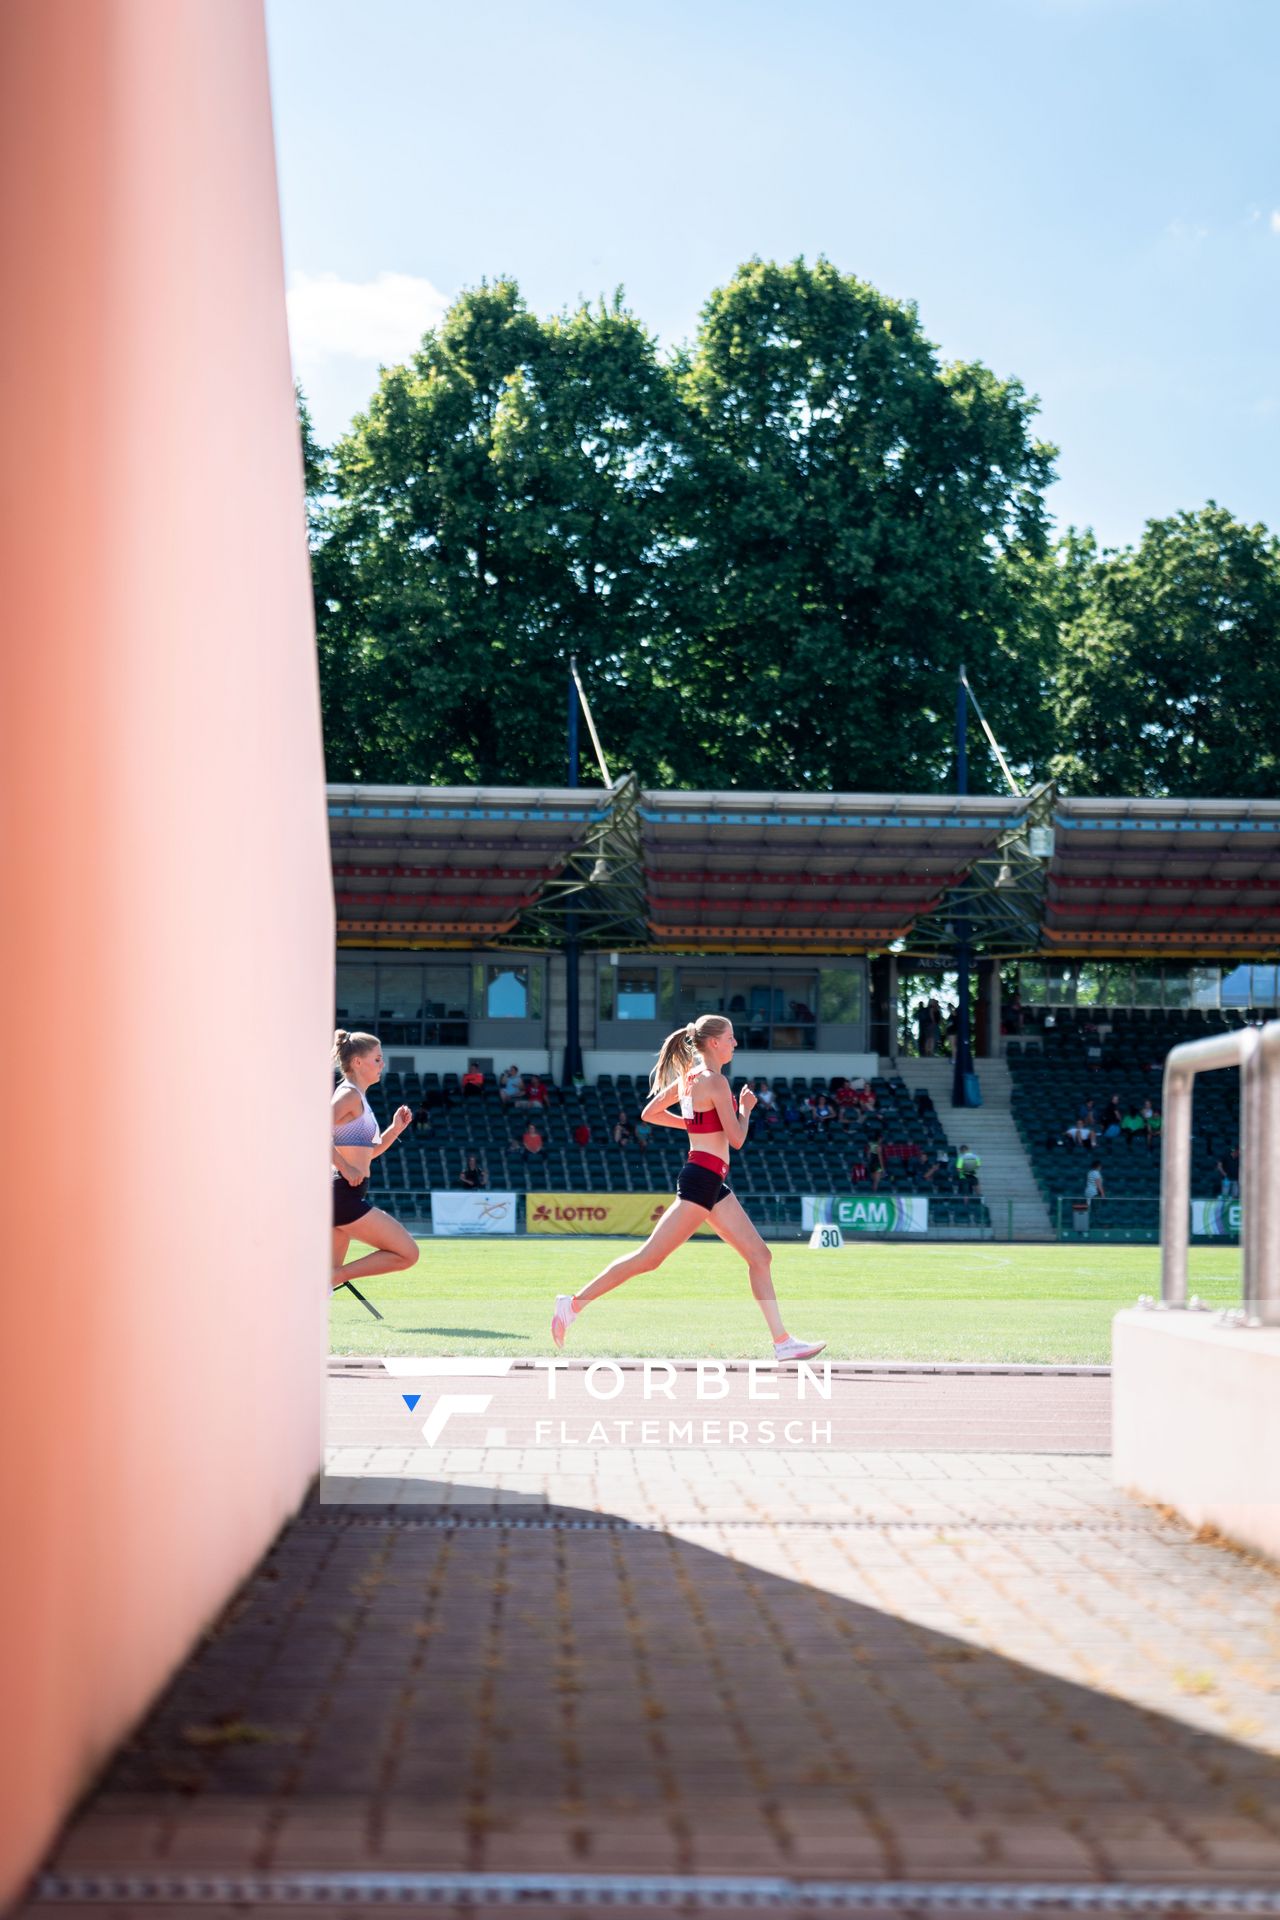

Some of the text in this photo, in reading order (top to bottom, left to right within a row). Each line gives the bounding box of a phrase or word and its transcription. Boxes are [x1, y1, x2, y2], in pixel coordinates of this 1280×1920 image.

[555, 1207, 607, 1220] LOTTO
[839, 1202, 887, 1222] EAM
[821, 1229, 840, 1248] 30
